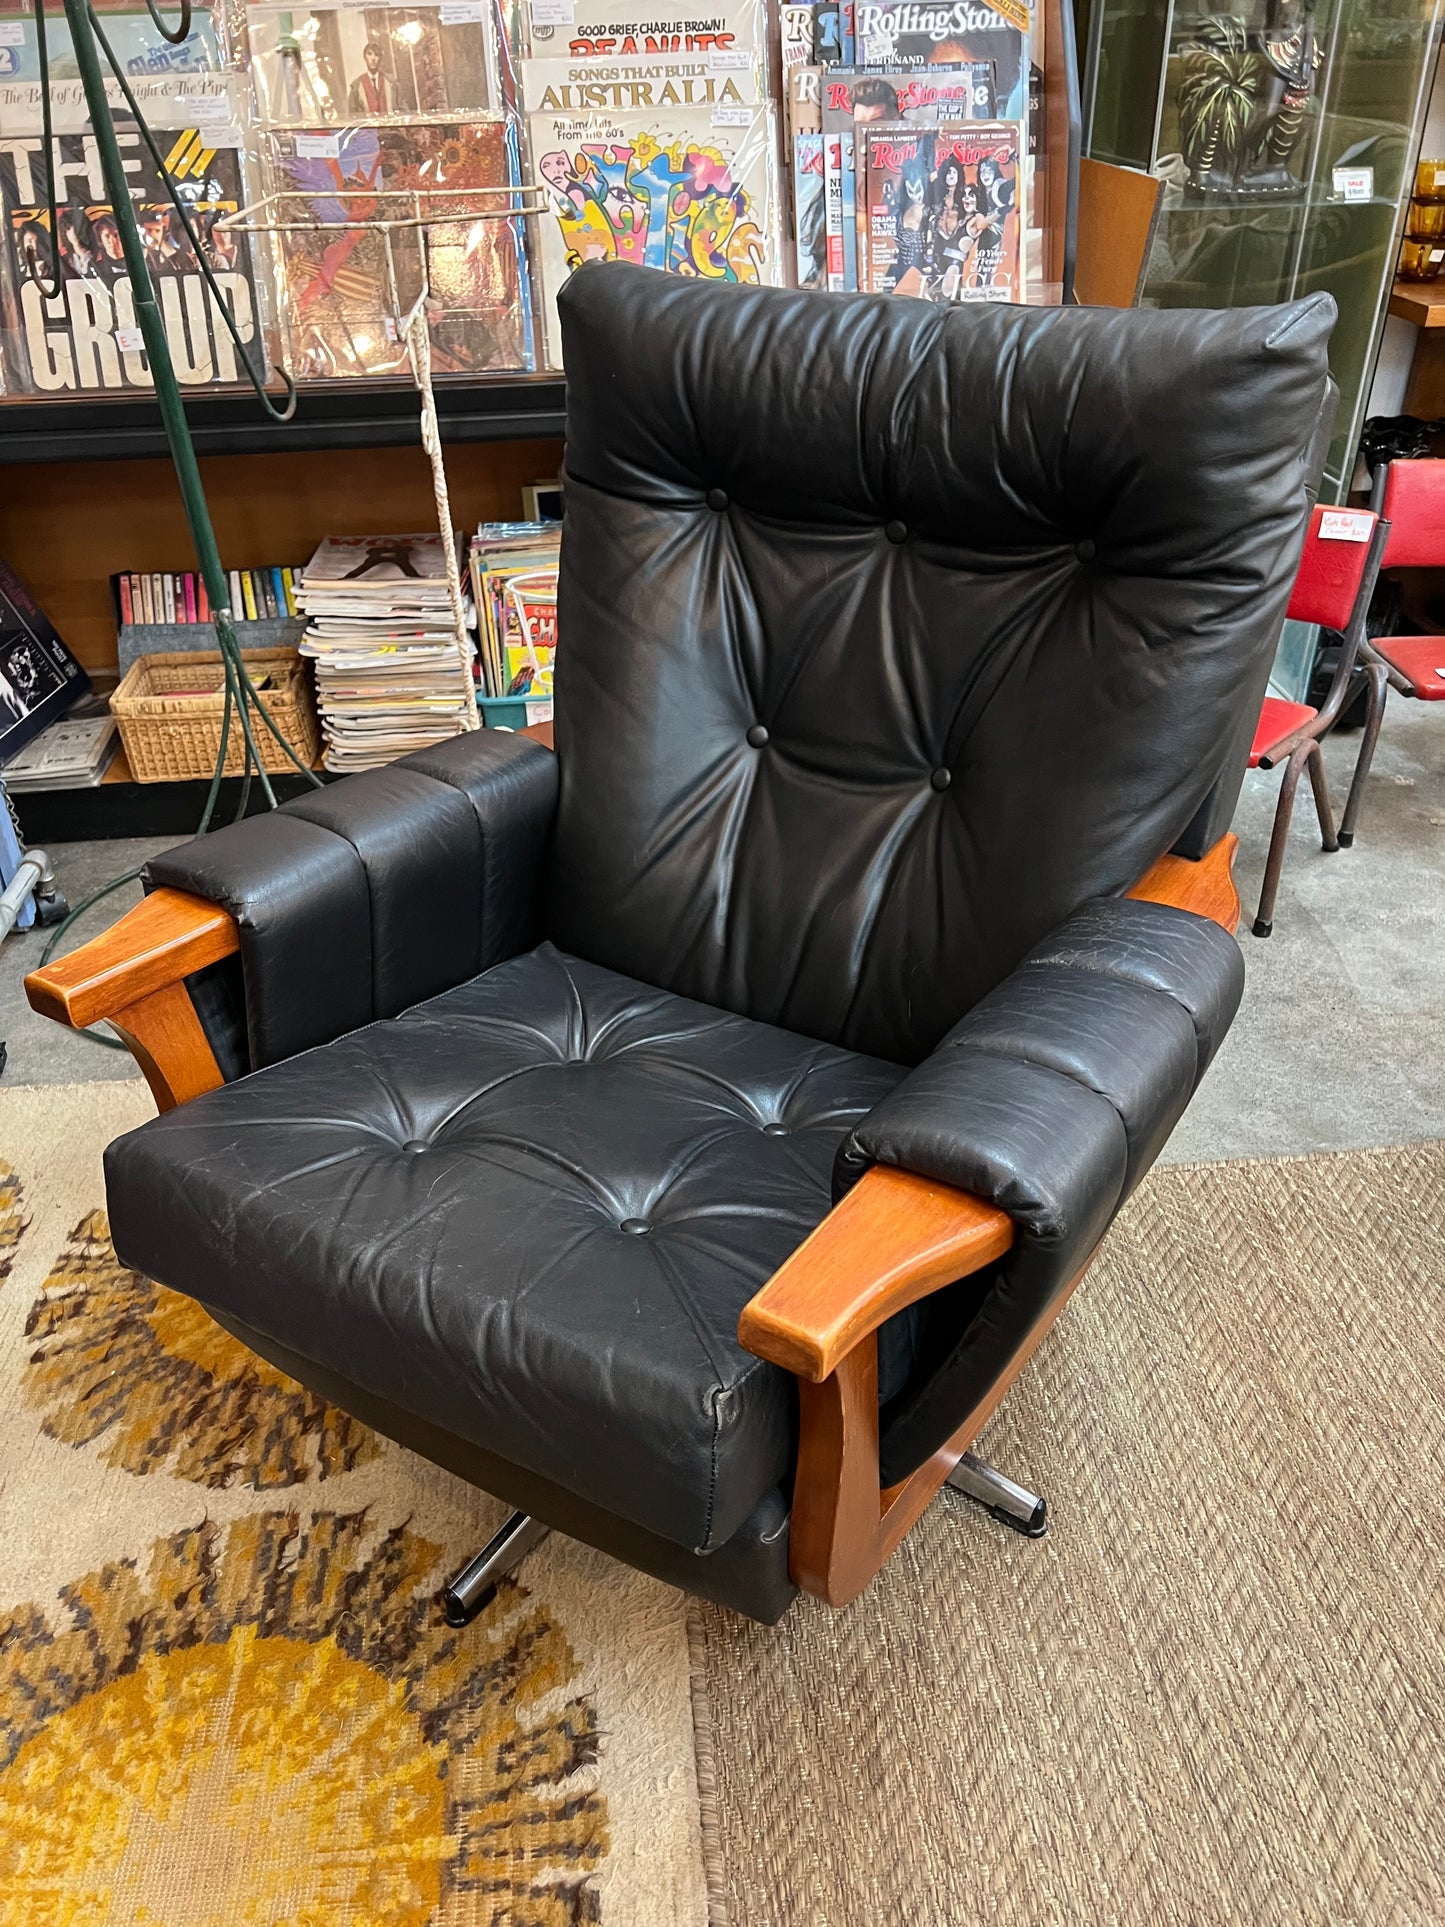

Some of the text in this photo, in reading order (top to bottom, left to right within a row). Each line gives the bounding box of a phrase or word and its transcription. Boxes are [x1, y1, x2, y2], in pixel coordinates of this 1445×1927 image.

[577, 25, 607, 37] GOOD
[639, 21, 683, 34] CHARLIE
[568, 64, 708, 81] SONGS THAT BUILT
[2, 86, 23, 104] The
[57, 86, 71, 105] of
[175, 79, 198, 97] The
[538, 77, 745, 111] AUSTRALIA
[553, 119, 566, 131] All
[557, 130, 582, 140] From
[605, 128, 625, 138] 60's
[990, 132, 1012, 140] GEORGE
[1, 134, 146, 206] THE
[872, 215, 897, 223] OBAMA
[872, 230, 898, 238] HAWKS
[986, 249, 1008, 258] Years
[20, 273, 254, 390] GROUP
